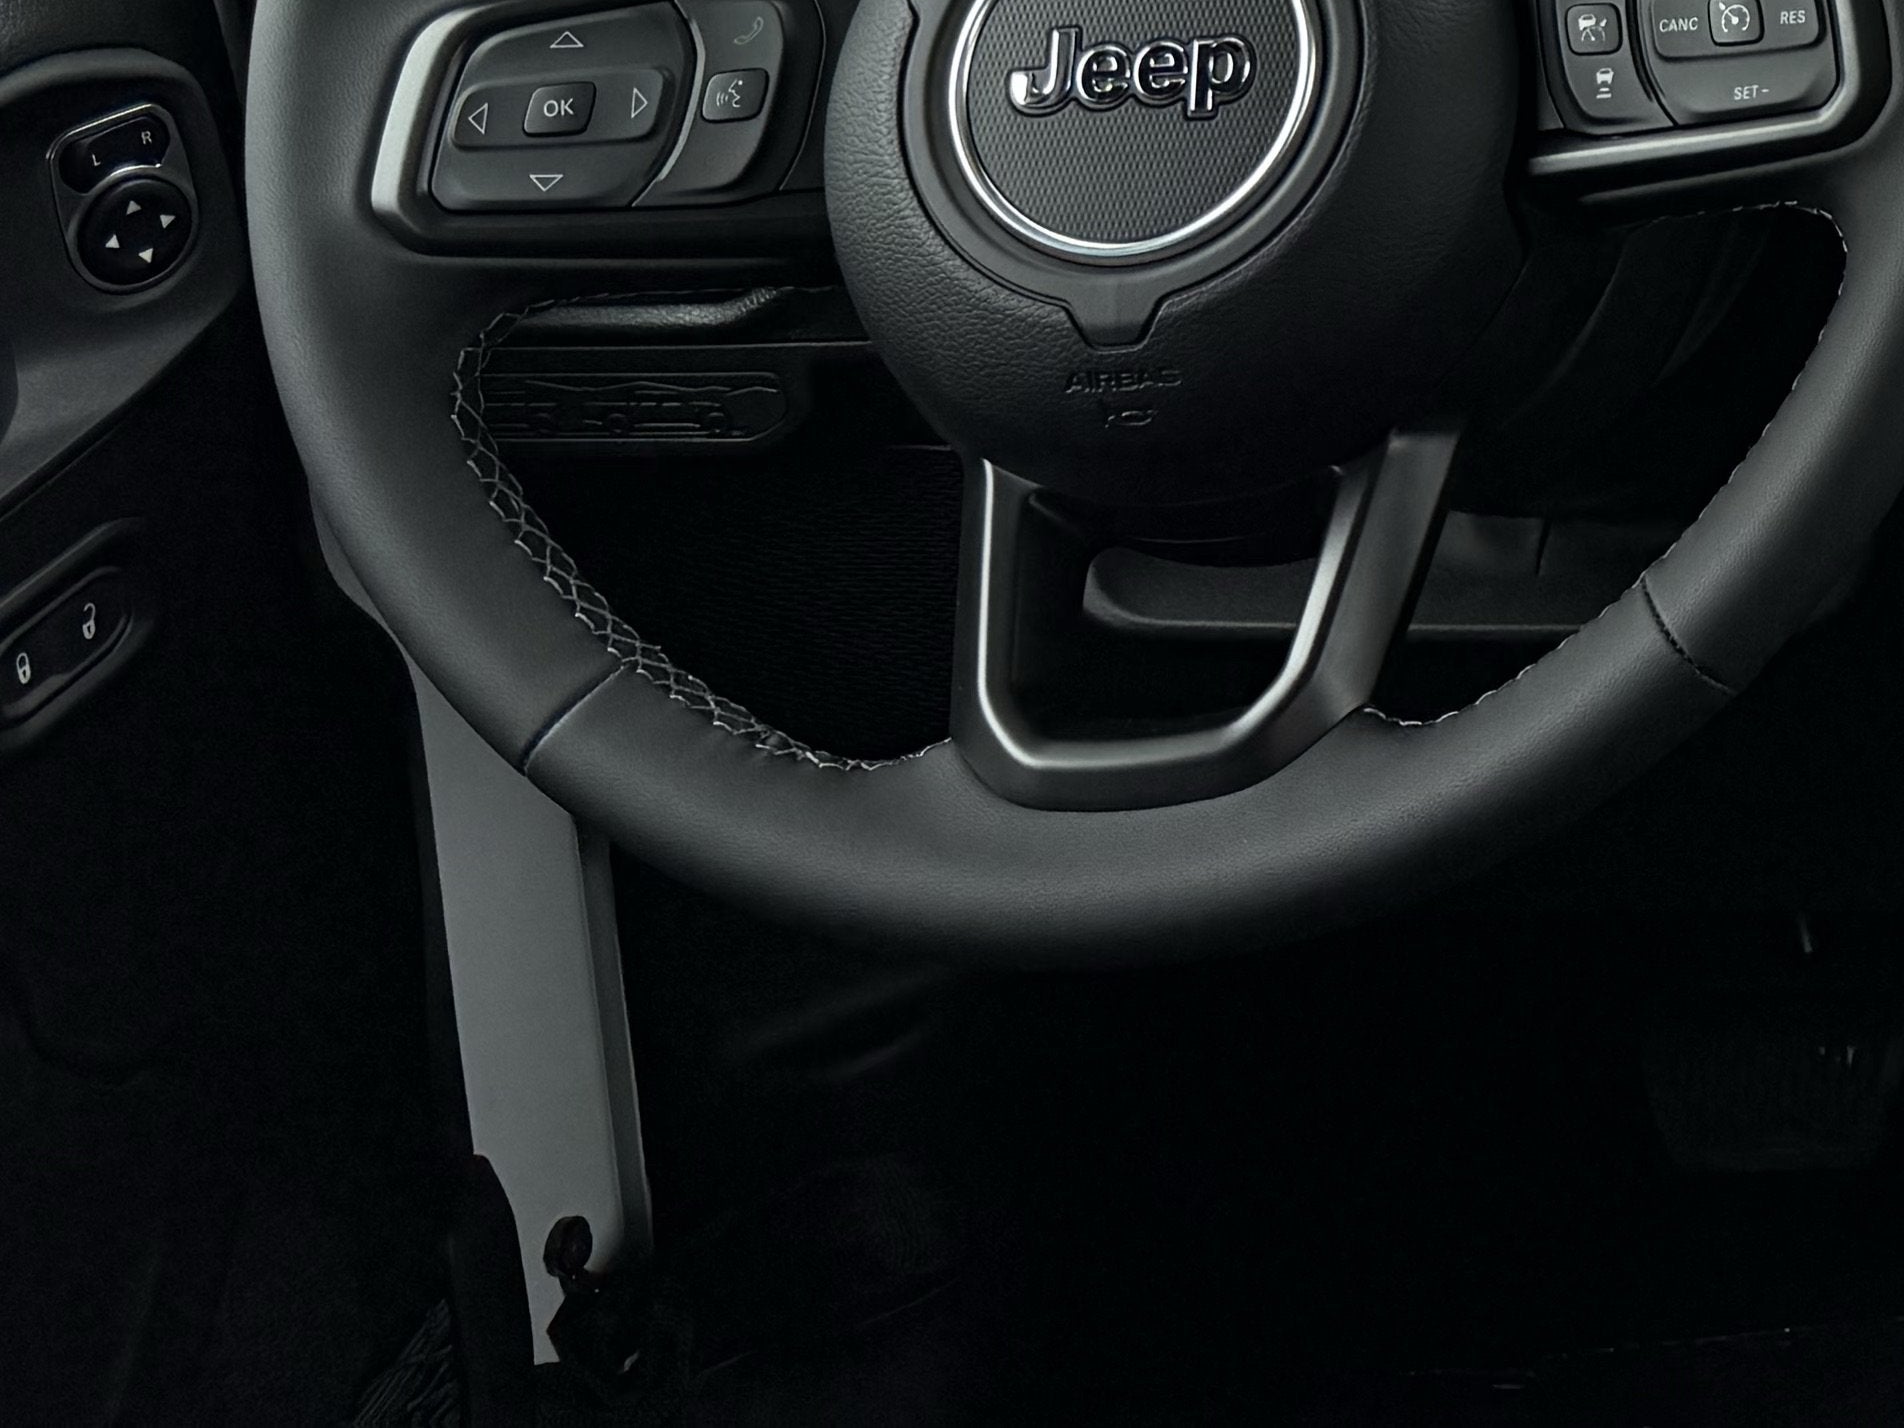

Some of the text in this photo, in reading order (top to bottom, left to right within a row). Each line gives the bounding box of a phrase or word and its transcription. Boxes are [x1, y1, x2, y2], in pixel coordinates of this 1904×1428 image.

[1659, 17, 1699, 32] CANC
[1780, 10, 1806, 25] RES
[1007, 26, 1257, 119] Jeep
[543, 98, 574, 117] OK
[141, 131, 152, 144] R
[92, 154, 101, 166] L
